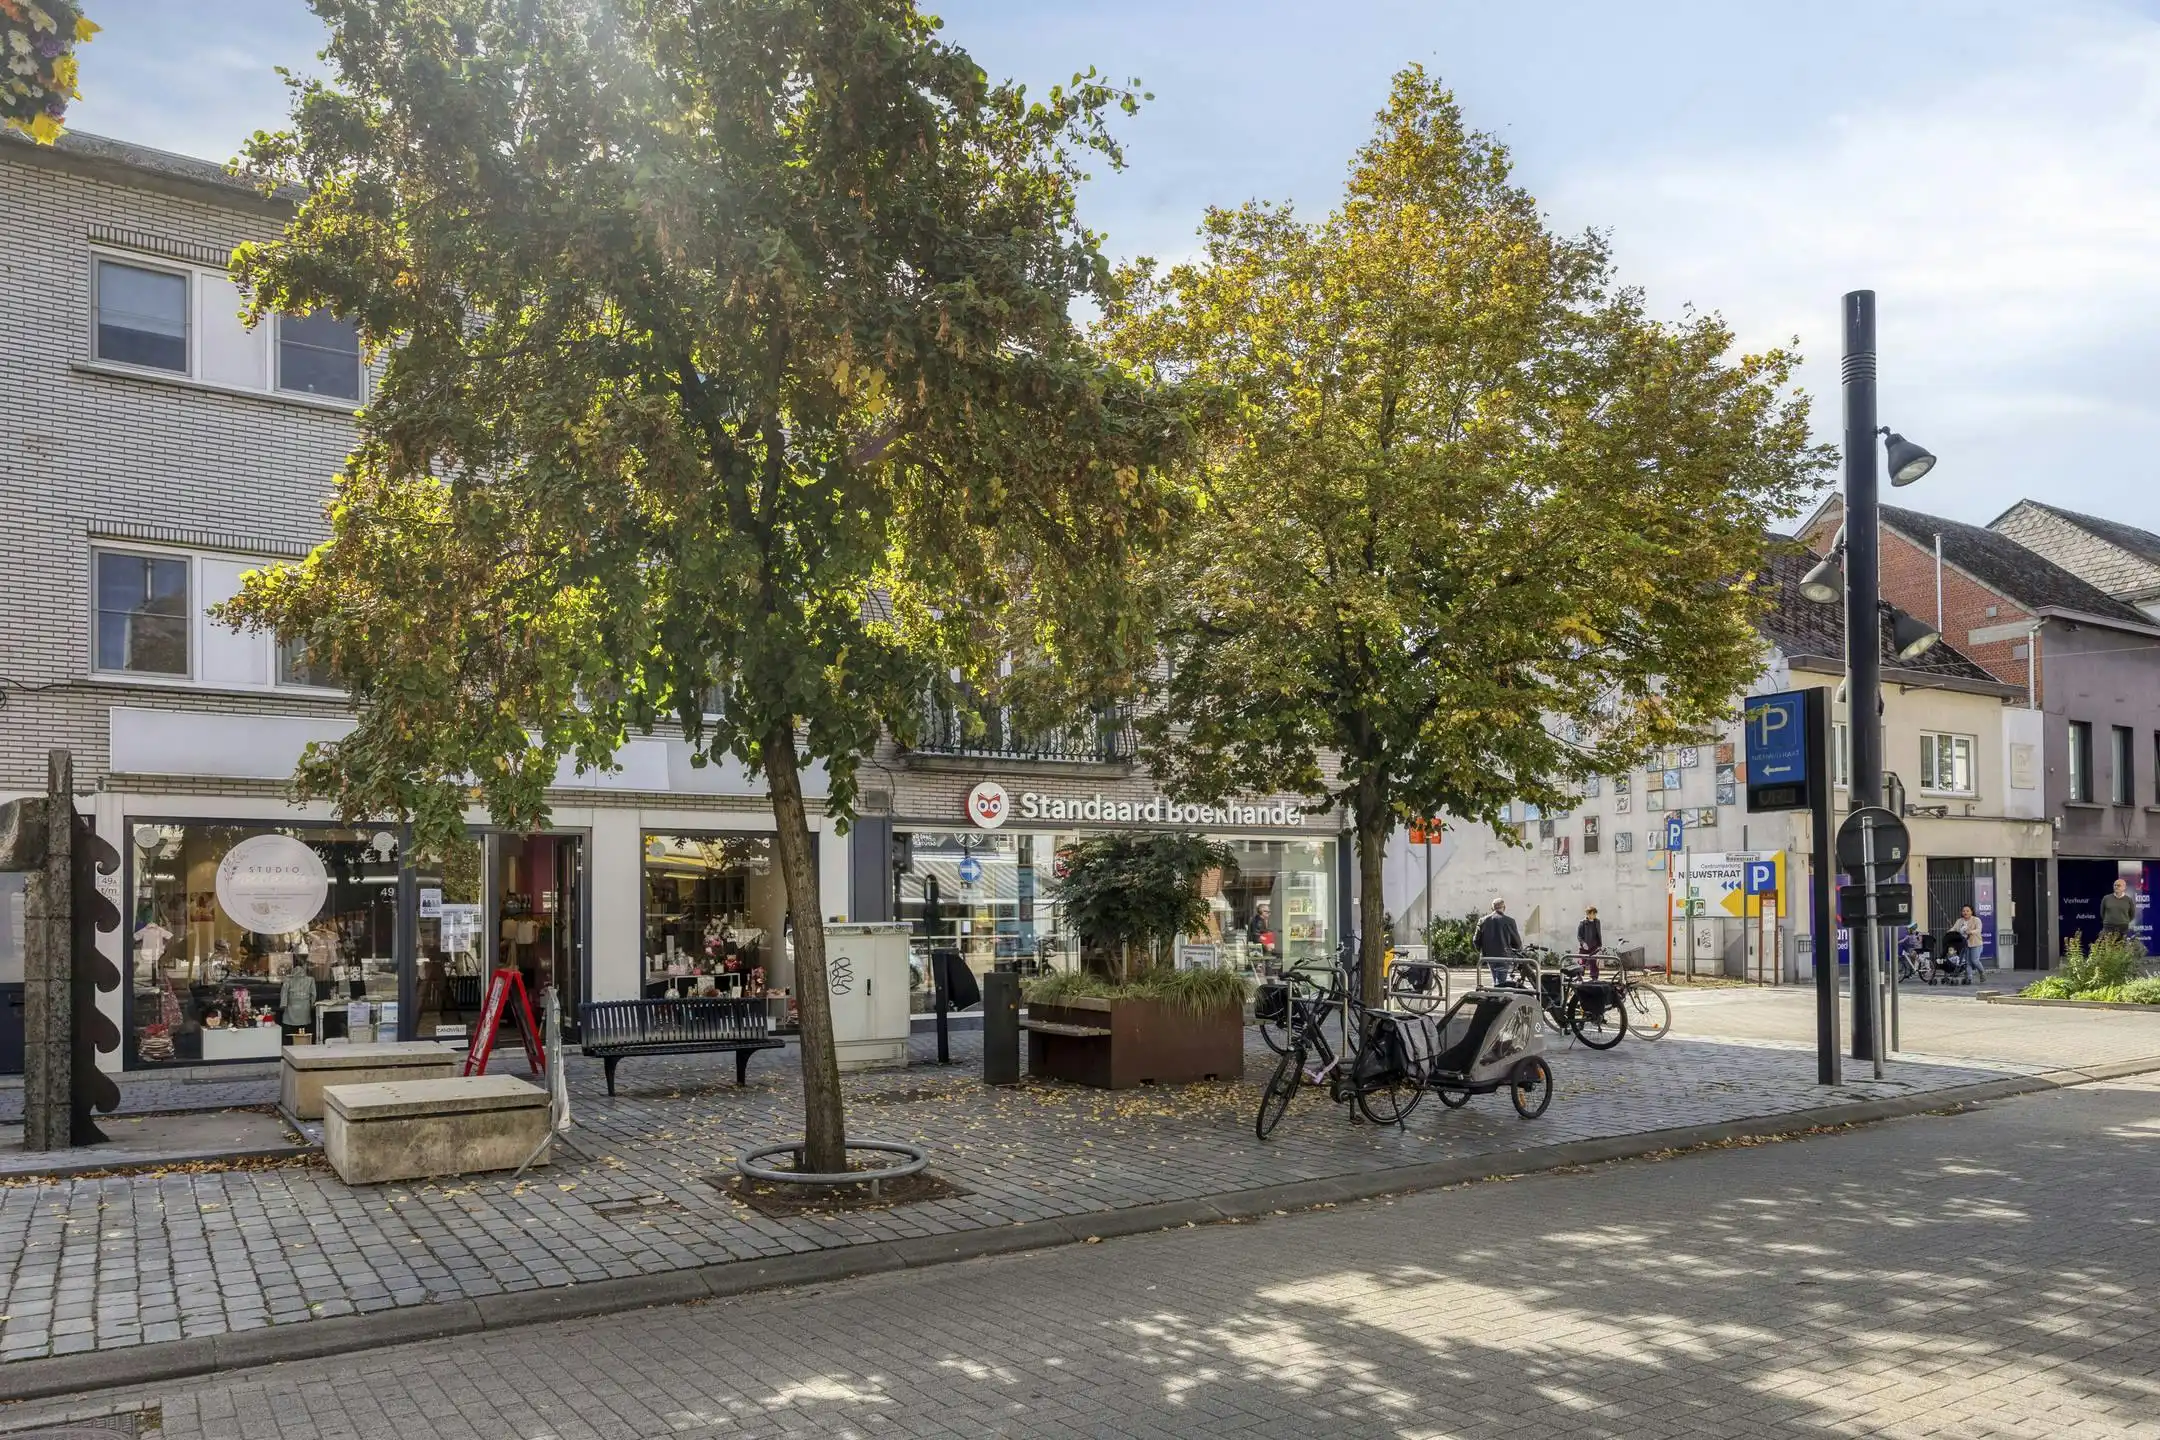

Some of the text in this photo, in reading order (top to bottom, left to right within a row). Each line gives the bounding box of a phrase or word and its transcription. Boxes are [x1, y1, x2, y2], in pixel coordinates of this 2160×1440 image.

[1762, 706, 1788, 746] P
[1020, 792, 1306, 826] Standaard Boekhandel
[1670, 824, 1681, 846] P
[249, 866, 300, 874] STUDIO
[1678, 870, 1741, 879] NEUWSTRAAT
[1753, 866, 1770, 891] P
[381, 887, 395, 897] 49
